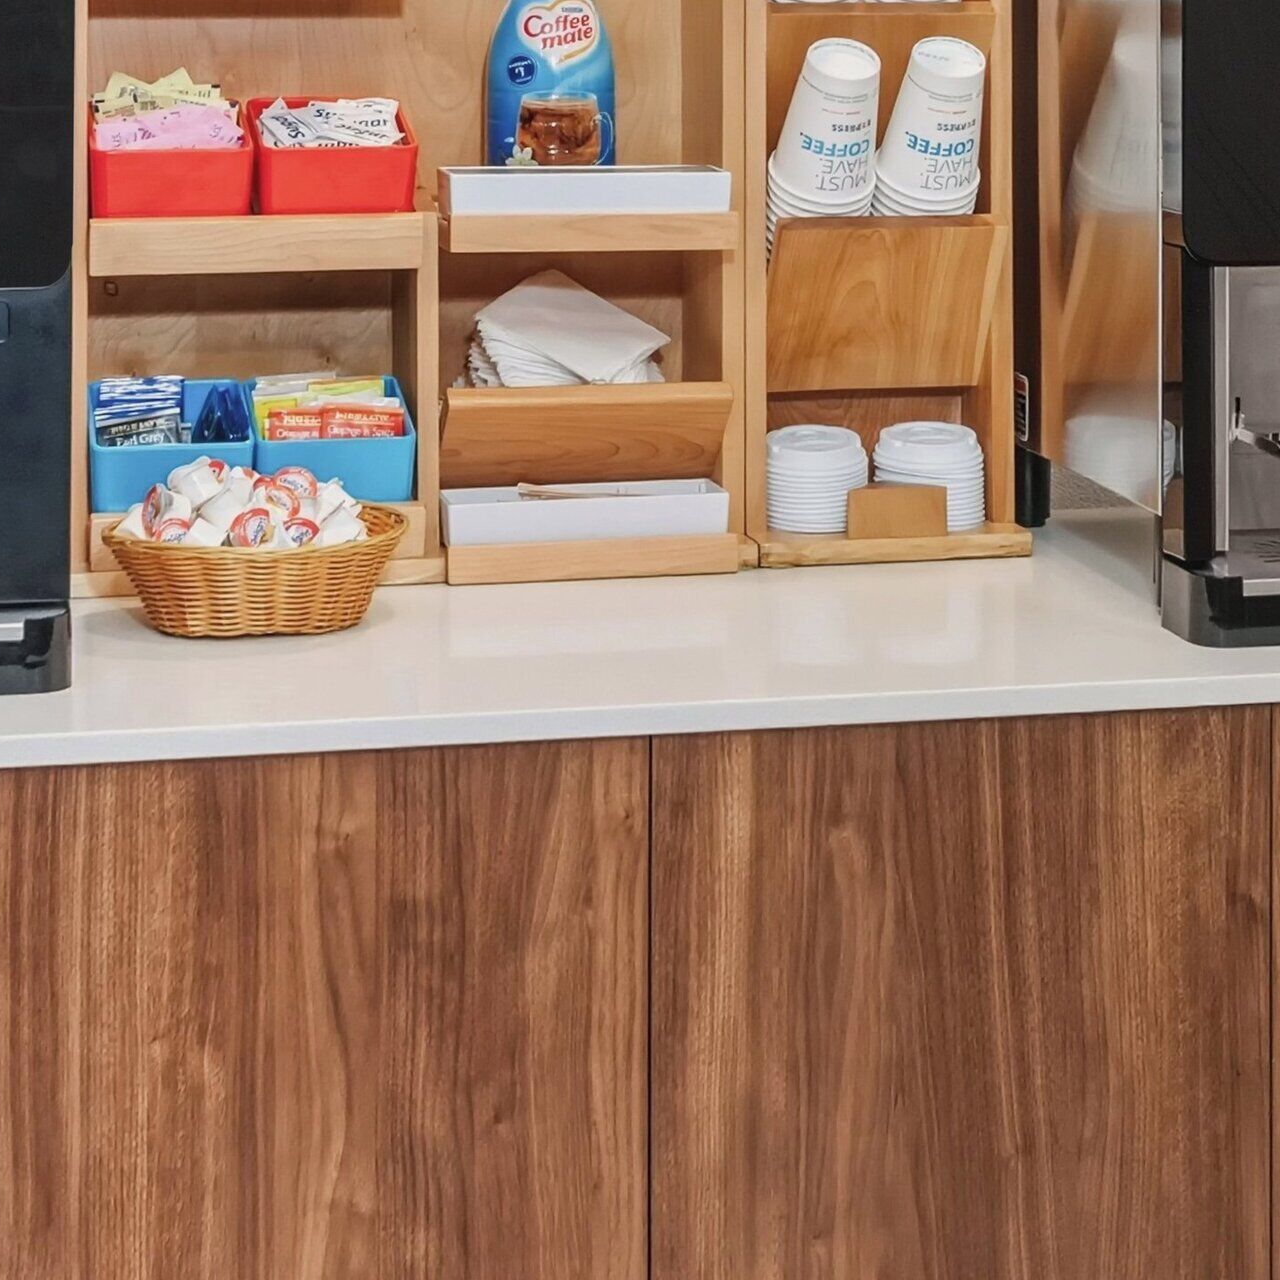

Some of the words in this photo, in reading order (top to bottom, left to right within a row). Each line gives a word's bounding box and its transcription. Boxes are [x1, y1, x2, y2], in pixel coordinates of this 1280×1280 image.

[524, 14, 590, 38] Coffee
[542, 26, 593, 49] mate
[800, 131, 869, 158] COFFEE.
[905, 131, 974, 156] COFFEE.
[819, 157, 867, 174] HAVE.
[923, 157, 972, 174] HAVE.
[815, 173, 867, 192] MUST.
[920, 172, 971, 191] MUST.
